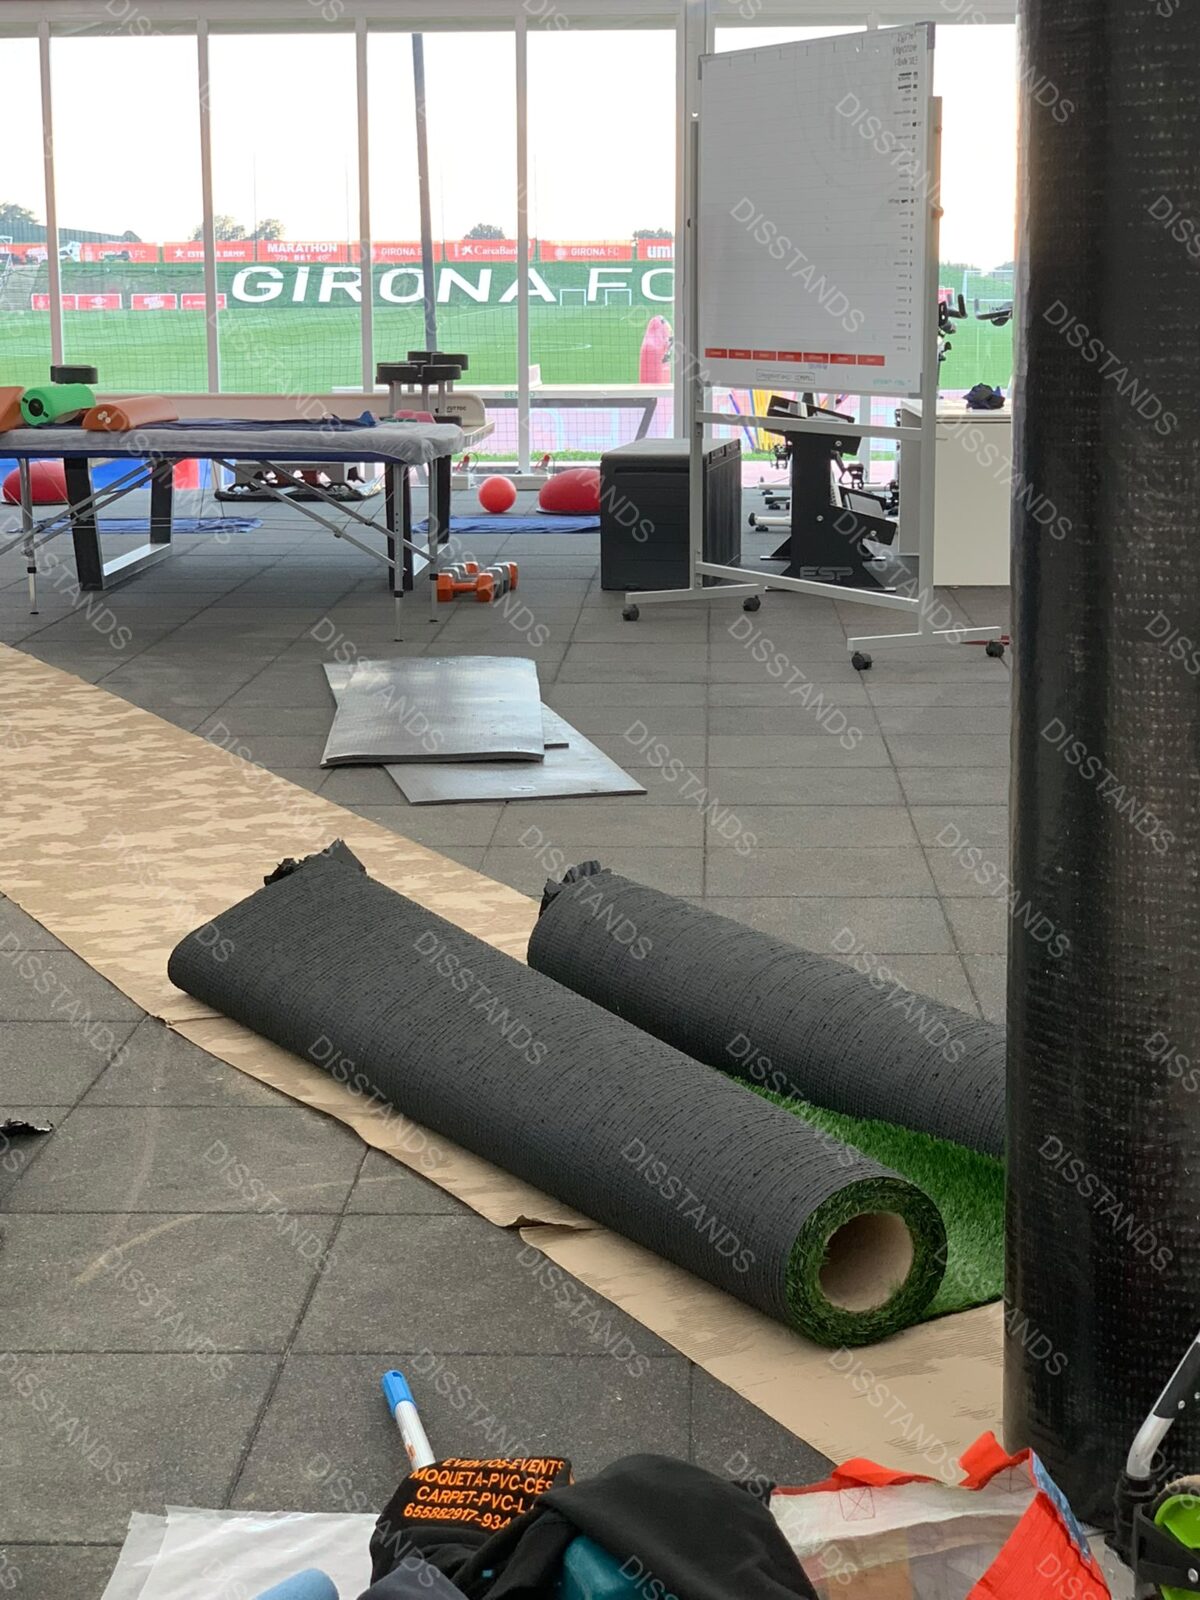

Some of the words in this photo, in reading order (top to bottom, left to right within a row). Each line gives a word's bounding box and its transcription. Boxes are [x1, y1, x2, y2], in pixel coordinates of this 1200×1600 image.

[267, 243, 337, 253] MARATHON
[381, 247, 416, 256] GIRONA
[570, 247, 605, 256] GIRONA
[607, 248, 620, 256] FC
[231, 265, 557, 303] GIRONA
[416, 1485, 535, 1514] CARPET-PVC-L
